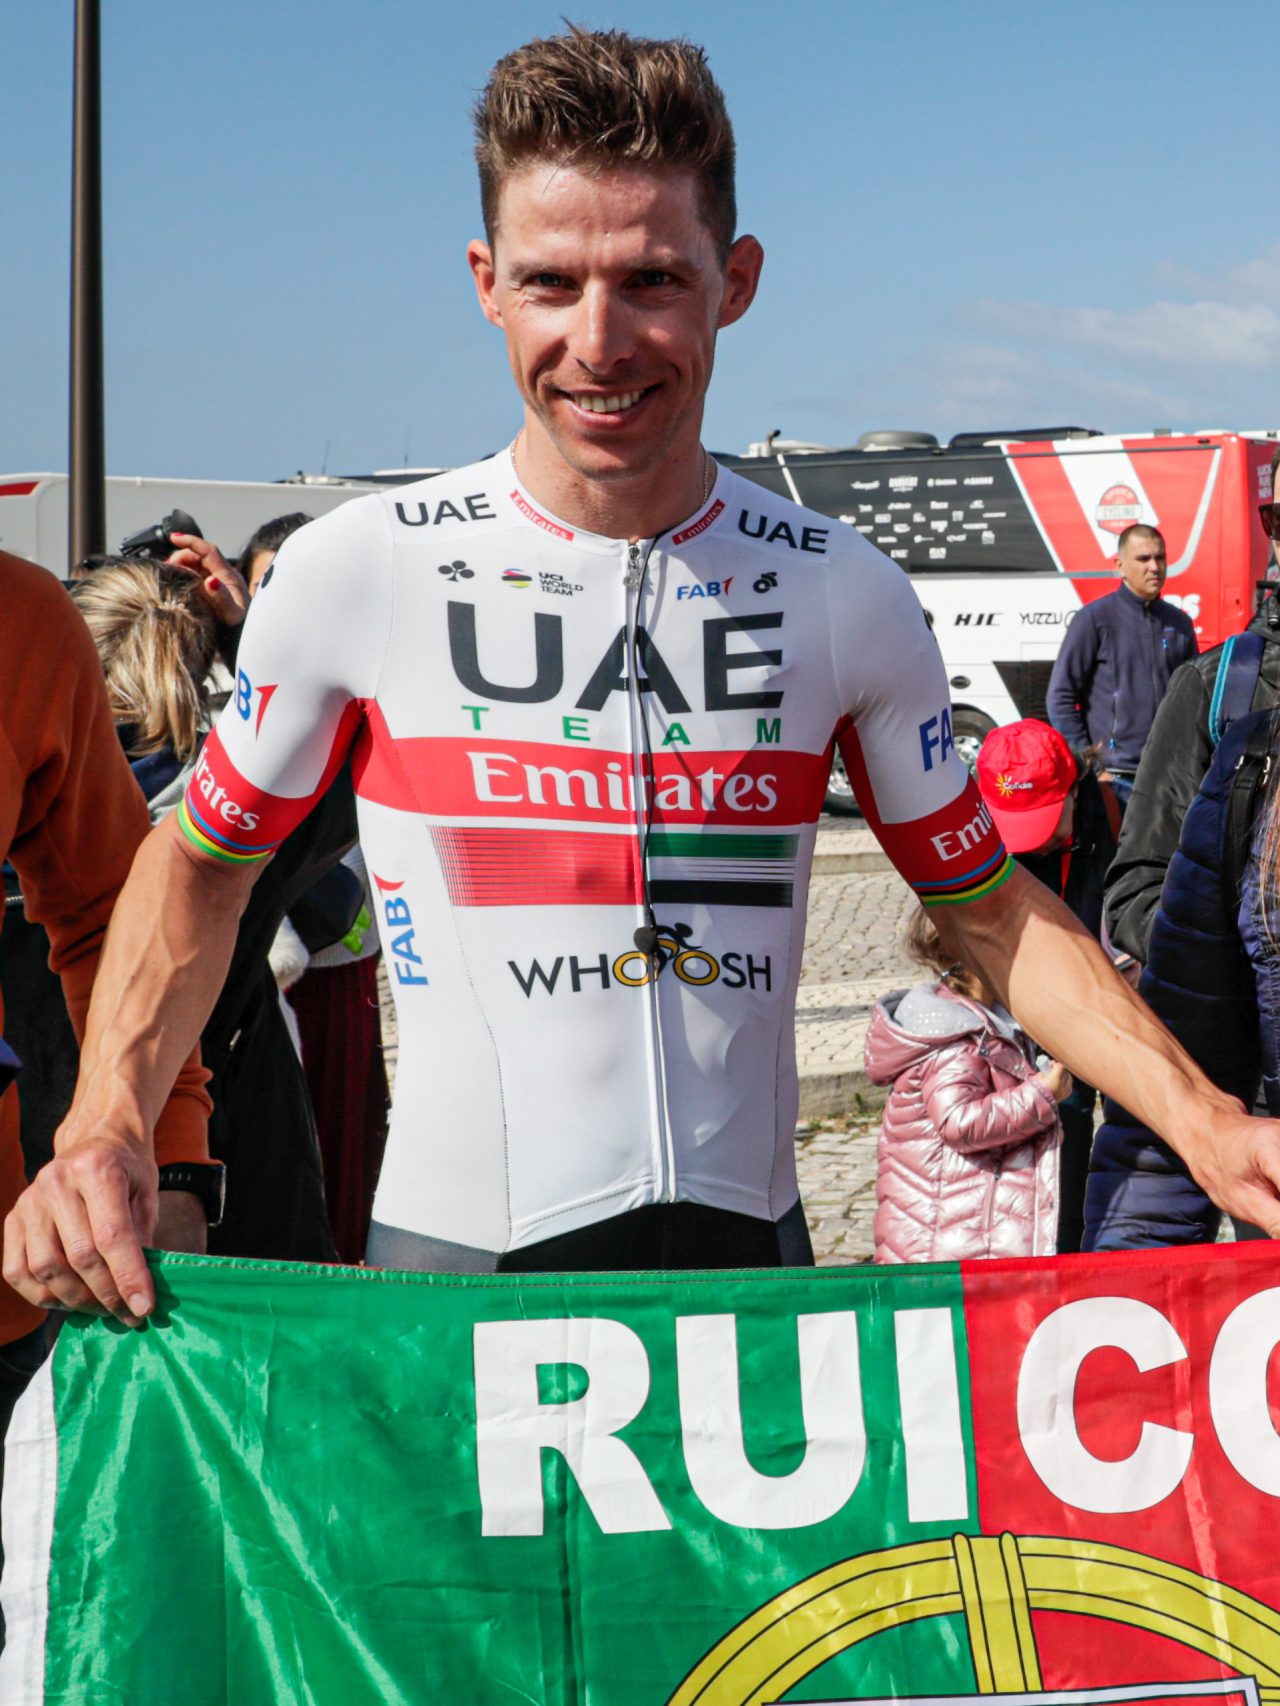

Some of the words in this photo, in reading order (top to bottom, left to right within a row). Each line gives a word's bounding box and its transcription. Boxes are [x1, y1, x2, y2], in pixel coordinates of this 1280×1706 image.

[395, 493, 497, 527] UAE
[512, 493, 568, 540] Emirates
[677, 503, 723, 543] Emirates
[738, 509, 829, 554] UAE
[538, 571, 564, 582] UCI
[539, 579, 584, 592] WORLD
[540, 585, 574, 597] TEAM
[447, 600, 784, 714] UAE
[460, 705, 782, 747] TEAM
[919, 707, 954, 772] FA
[466, 751, 778, 813] Emirates
[507, 948, 772, 999] WHOOSH
[472, 1306, 970, 1538] RUI
